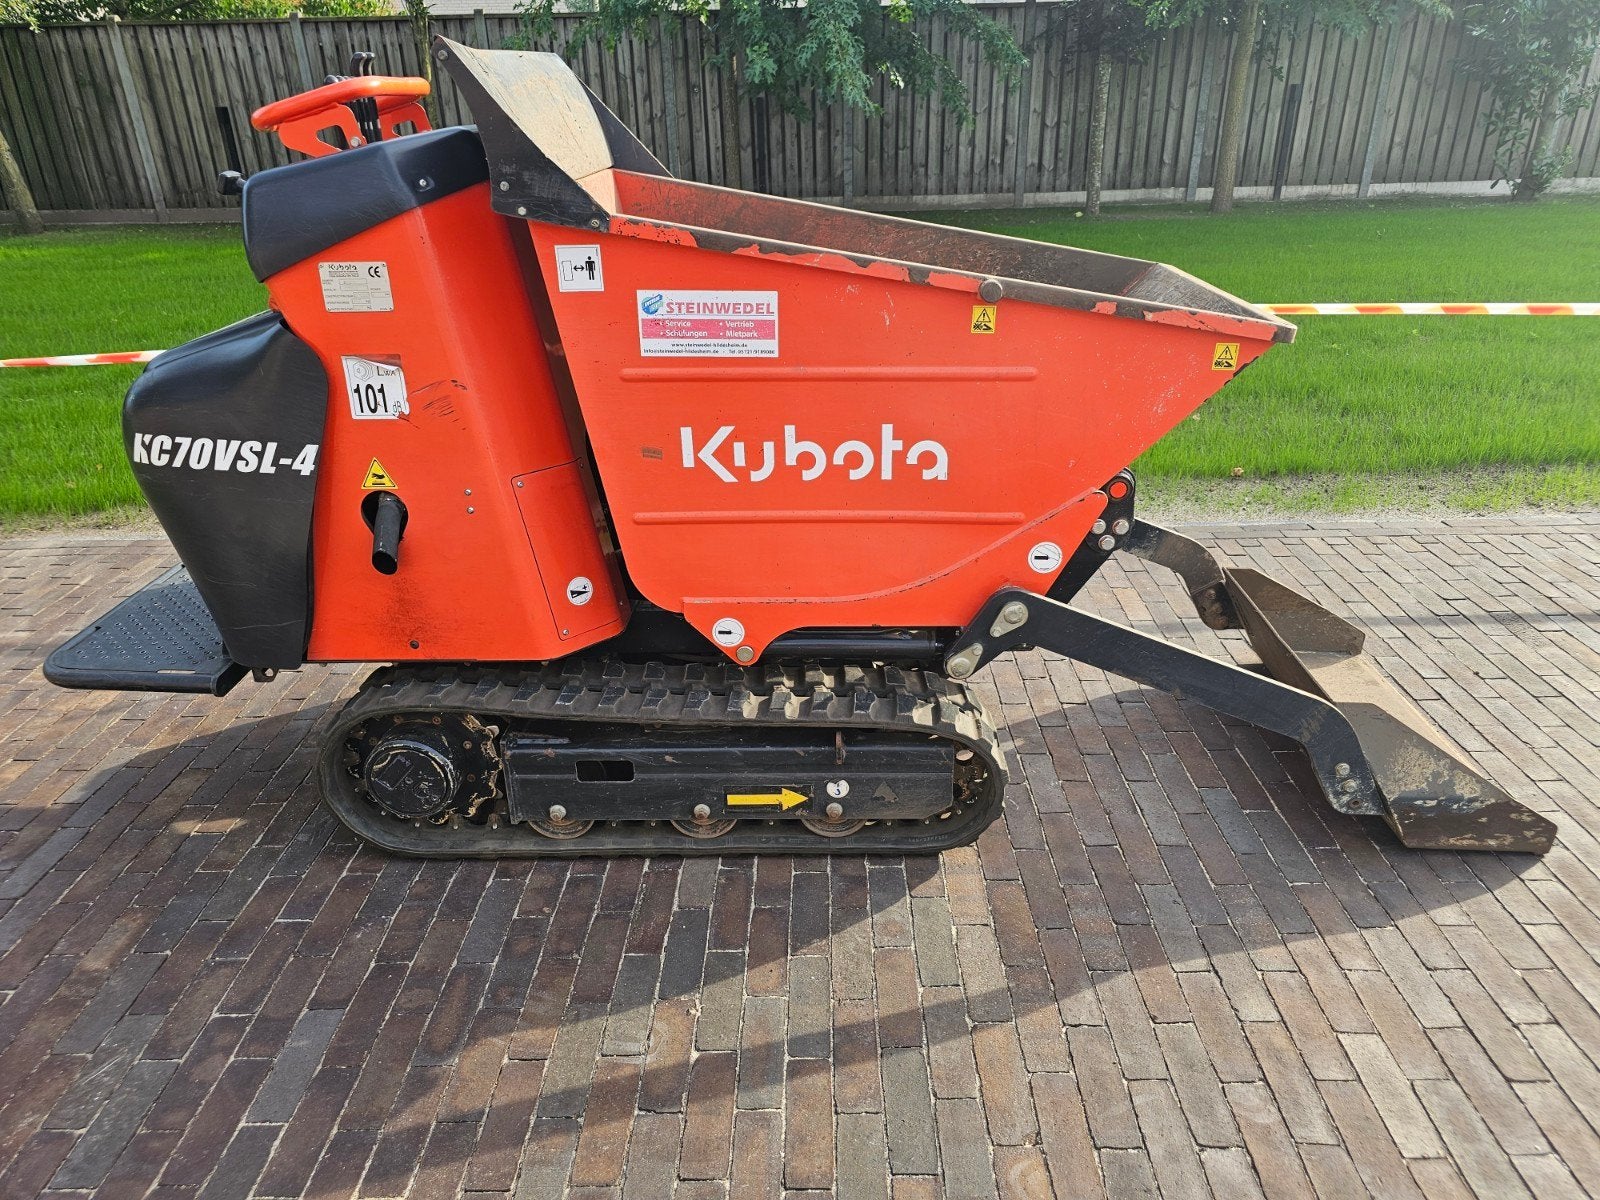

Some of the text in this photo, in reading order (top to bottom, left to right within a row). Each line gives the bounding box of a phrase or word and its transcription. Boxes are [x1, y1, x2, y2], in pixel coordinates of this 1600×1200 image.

[328, 263, 358, 271] Kubota
[367, 265, 382, 278] CE
[666, 302, 775, 315] STEINWEDEL
[665, 320, 691, 328] Service
[665, 330, 708, 339] Schulungen
[725, 330, 759, 339] Mietpark
[353, 383, 389, 413] 101
[133, 432, 319, 476] KC70VSL-4
[680, 423, 949, 482] Kubota
